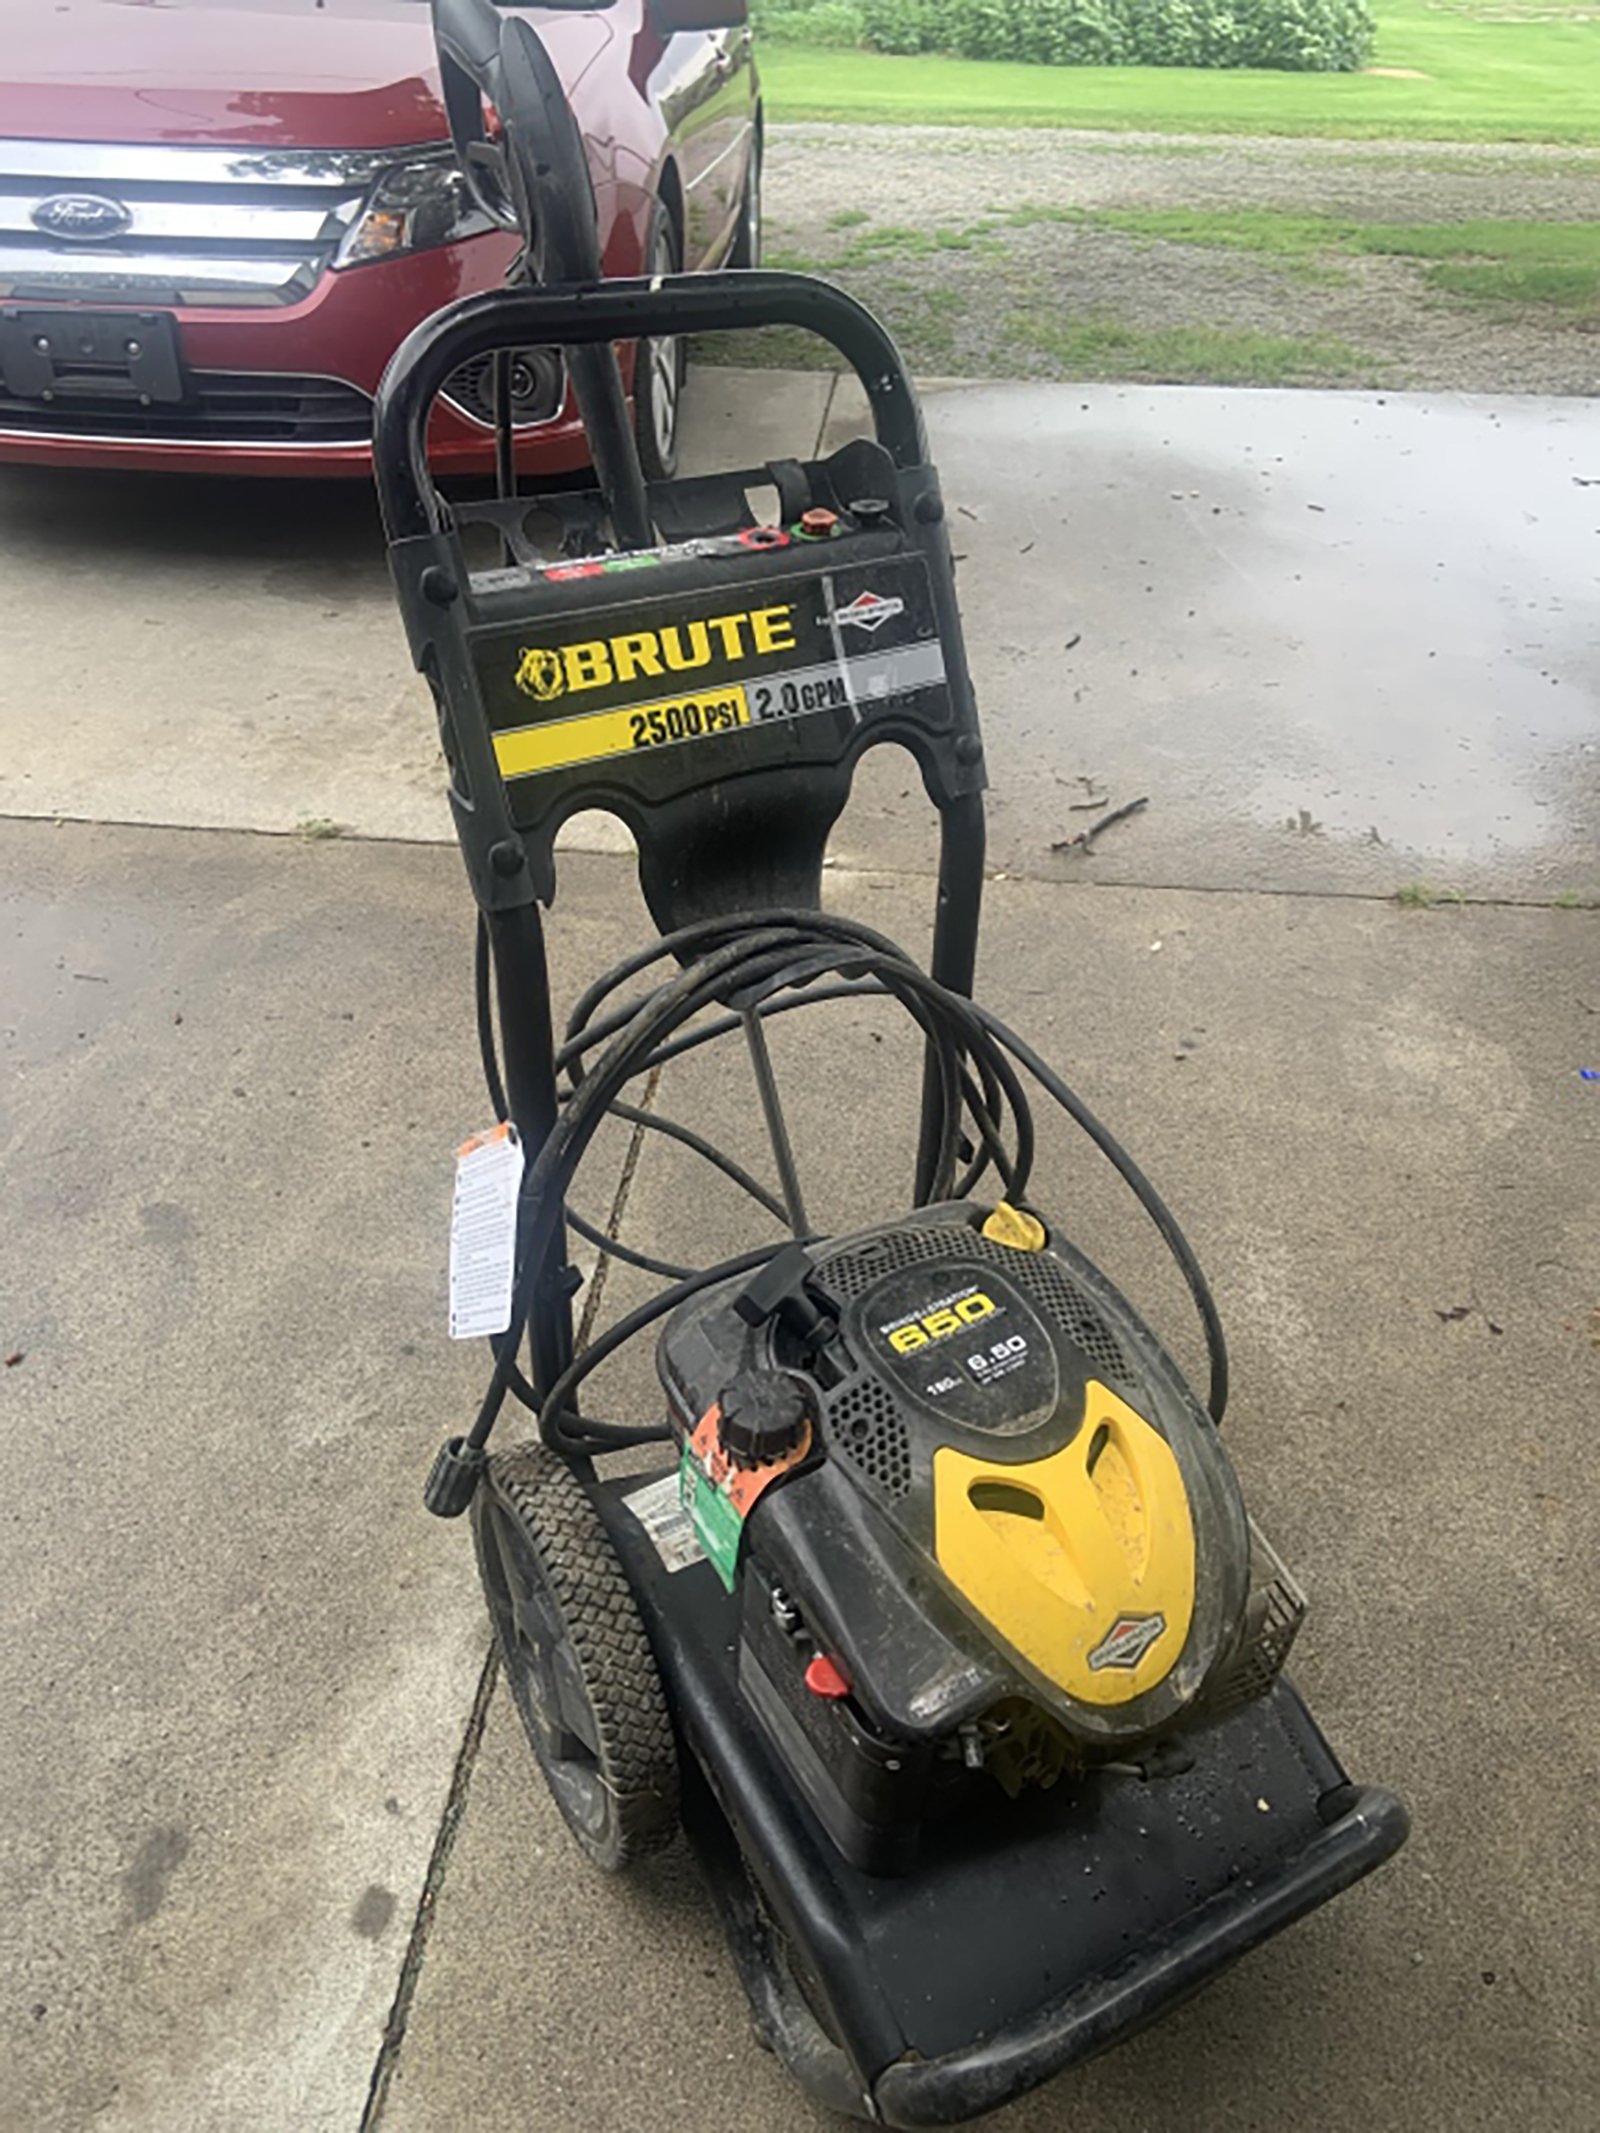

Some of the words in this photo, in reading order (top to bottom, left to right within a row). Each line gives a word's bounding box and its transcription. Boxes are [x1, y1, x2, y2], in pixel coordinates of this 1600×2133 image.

[49, 200, 104, 226] Ford
[560, 605, 796, 693] BRUTE
[629, 702, 701, 747] 2500
[703, 699, 741, 732] PSI
[755, 682, 799, 720] 2.0
[800, 676, 848, 711] GPM
[888, 1293, 996, 1353] 650
